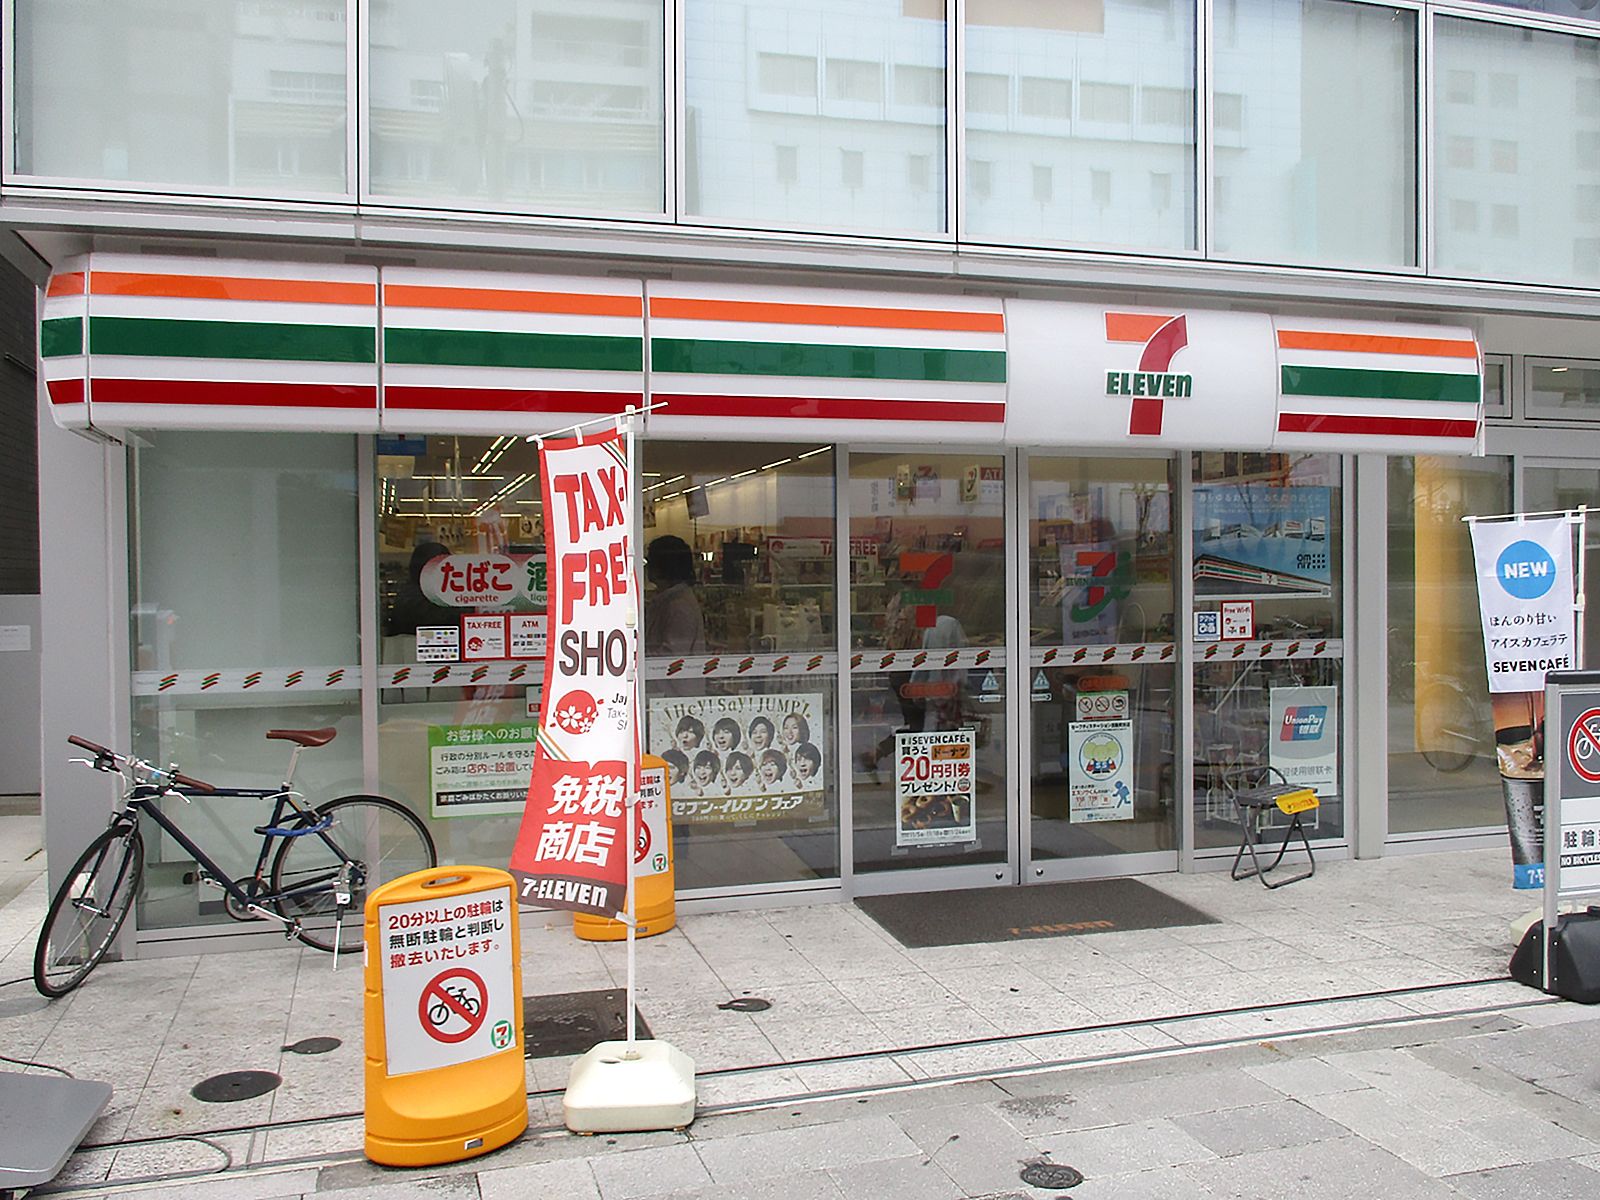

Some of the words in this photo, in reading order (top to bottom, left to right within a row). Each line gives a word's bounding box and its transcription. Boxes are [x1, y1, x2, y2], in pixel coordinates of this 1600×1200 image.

[441, 561, 513, 592] たばこ
[1504, 561, 1548, 578] NEW
[562, 535, 627, 624] FRE
[455, 593, 499, 603] cigarette
[1490, 613, 1557, 627] ほんのり甘い
[1491, 633, 1568, 649] アイスカフェラテ
[559, 629, 627, 676] SHO
[1494, 661, 1537, 672] SEVEN
[1540, 654, 1569, 670] CAFÉ
[1285, 714, 1323, 726] UnionPay
[912, 736, 942, 745] SEVEN
[934, 747, 968, 757] ドーナツ
[547, 774, 625, 818] 免税
[534, 820, 616, 867] 商店
[1564, 829, 1600, 848] 駐輪
[388, 899, 504, 930] 20分以上の駐輪は
[389, 918, 504, 949] 無断駐輪と判断し
[390, 939, 500, 968] 撤去いたします。
